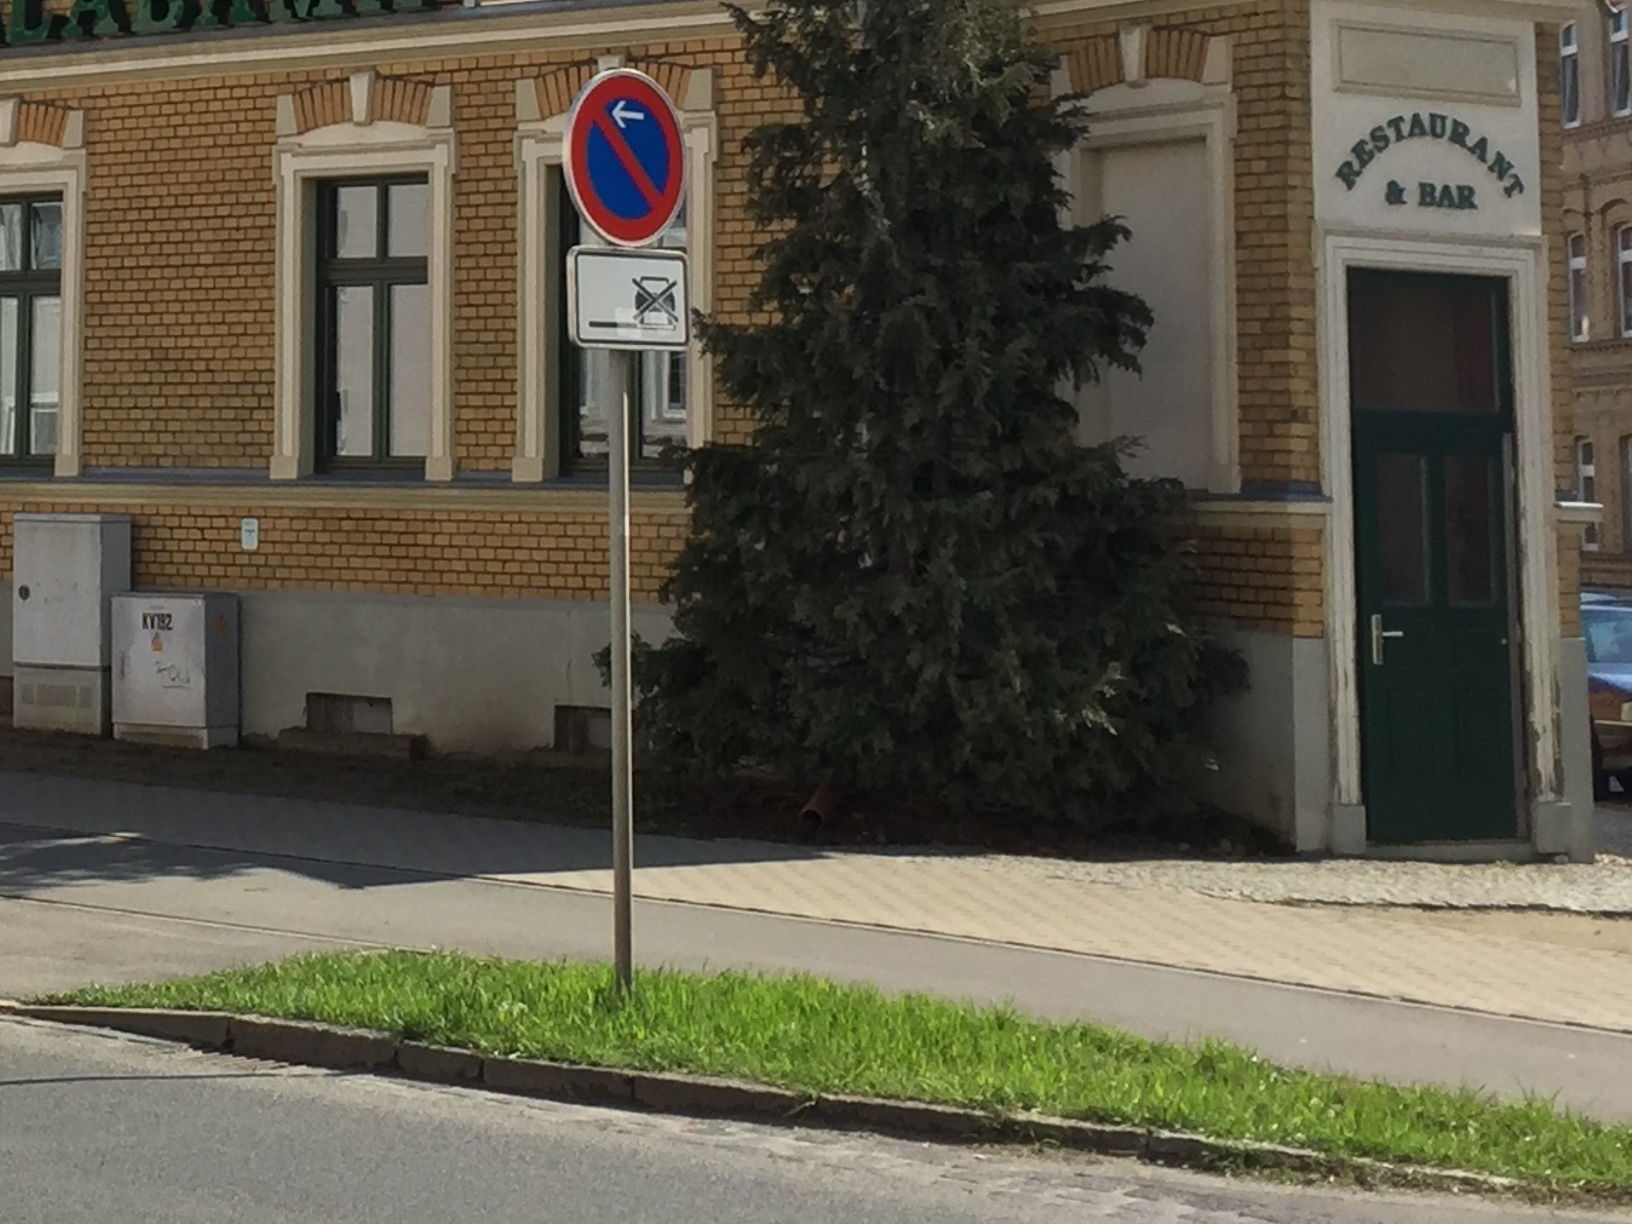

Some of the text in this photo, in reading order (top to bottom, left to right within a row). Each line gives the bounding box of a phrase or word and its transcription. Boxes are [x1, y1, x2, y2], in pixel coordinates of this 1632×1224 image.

[1335, 112, 1524, 198] RESTAURANT
[1385, 180, 1478, 210] & BAR
